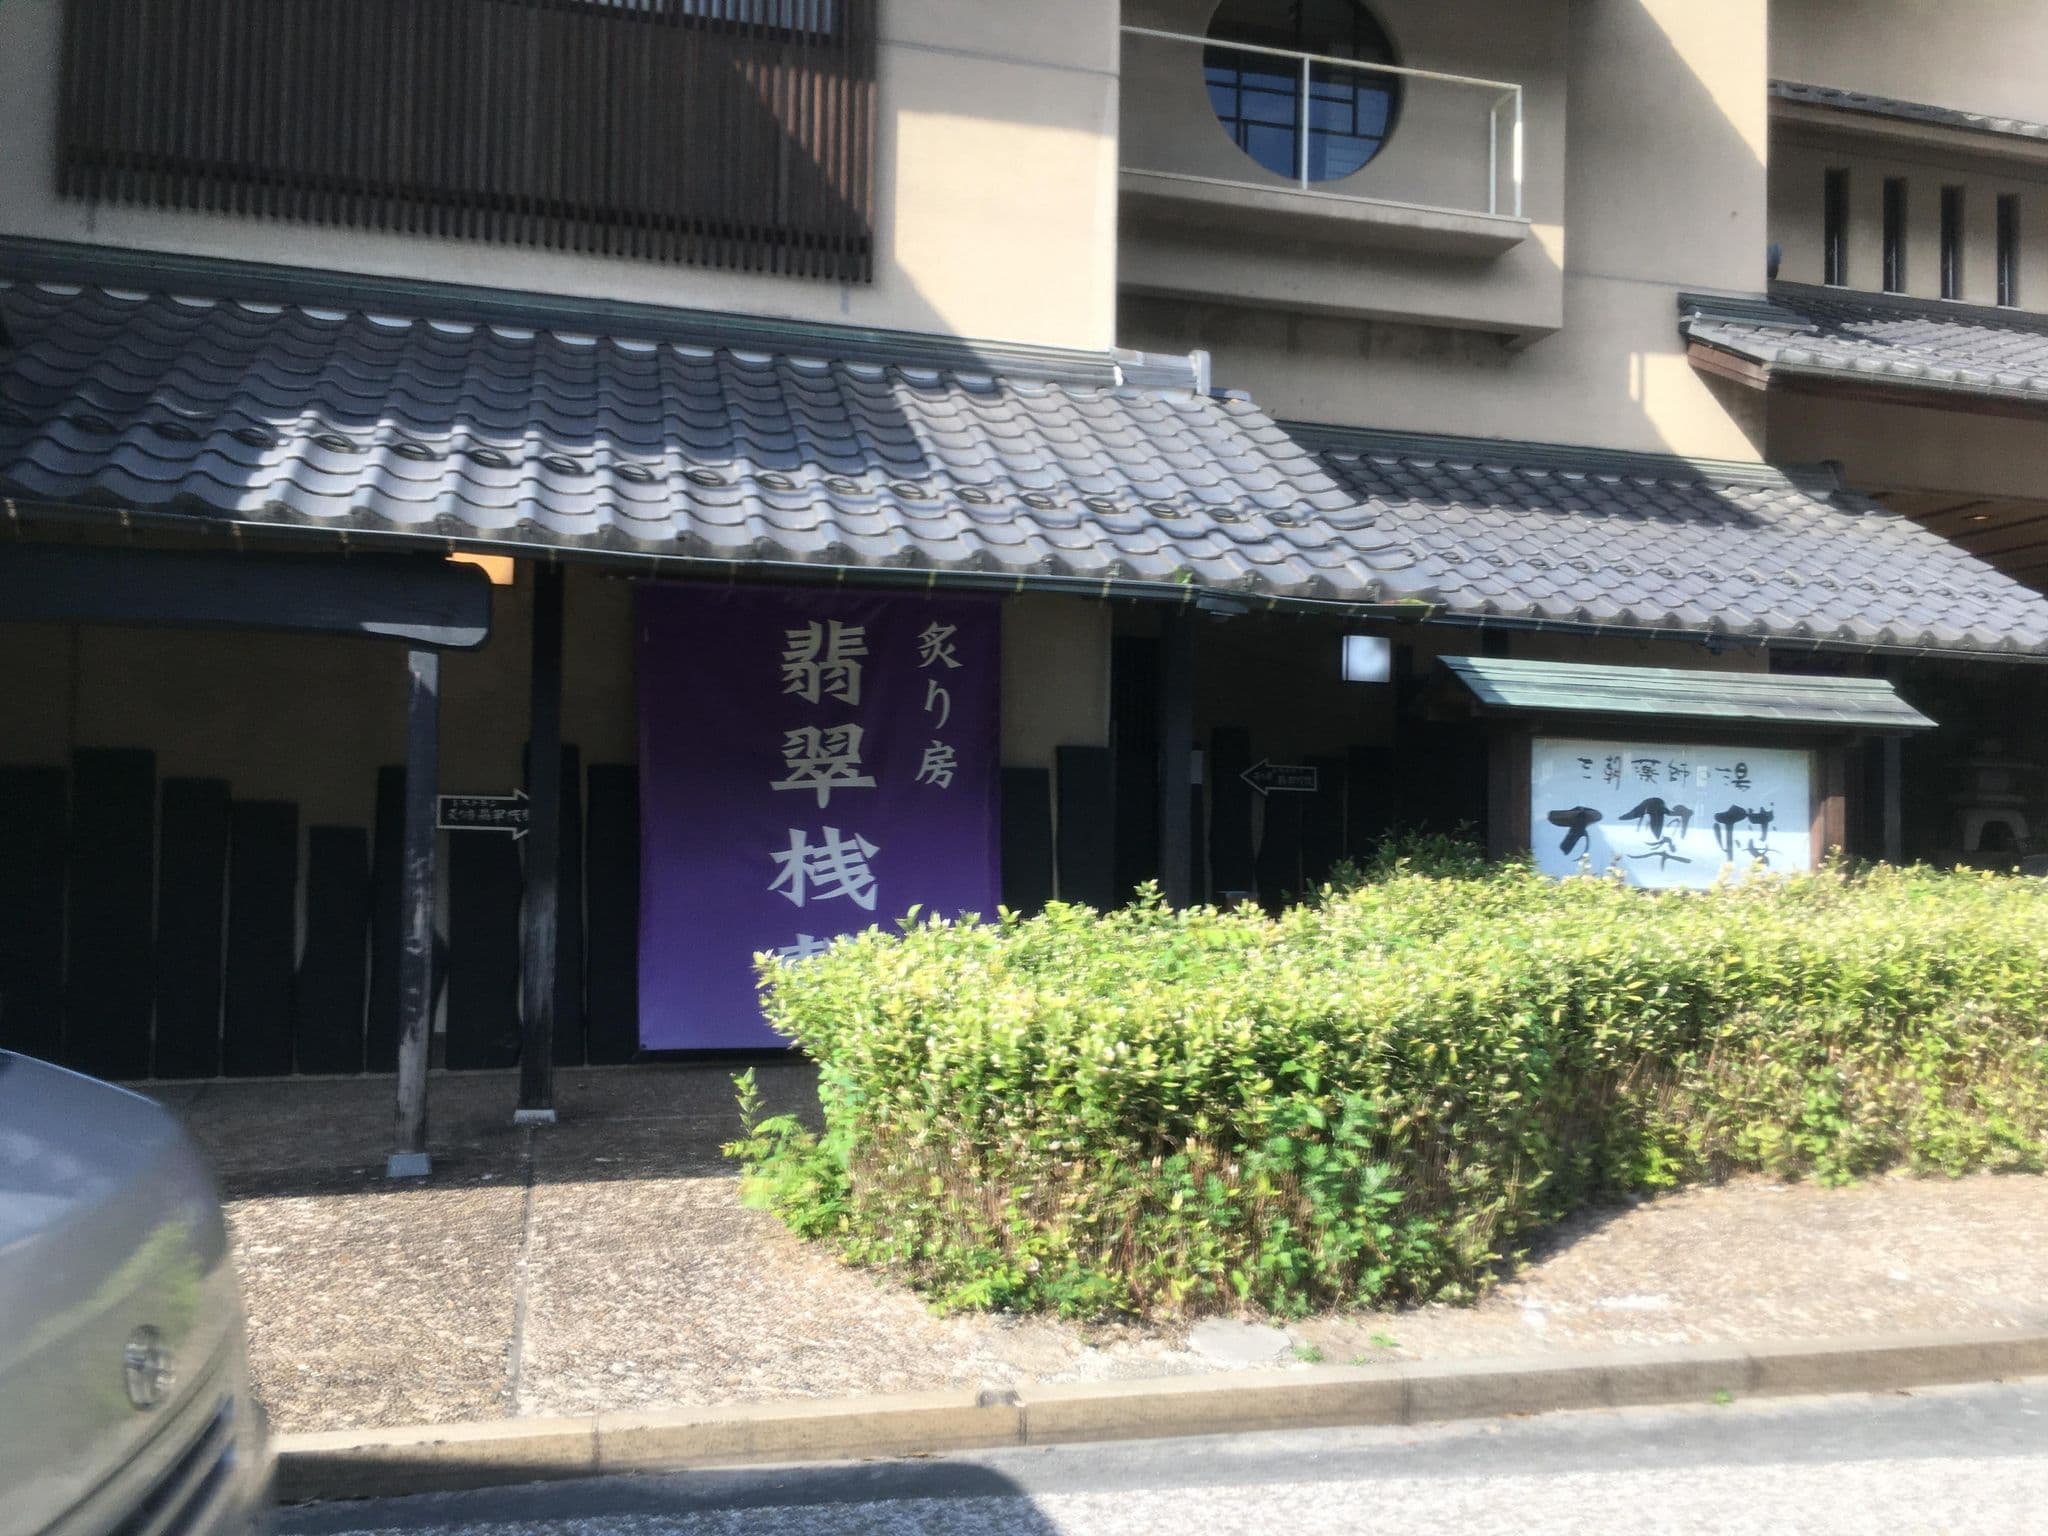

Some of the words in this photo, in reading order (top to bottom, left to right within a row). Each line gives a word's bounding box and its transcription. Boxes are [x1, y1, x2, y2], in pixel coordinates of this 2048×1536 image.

[767, 619, 881, 966] 翡翠桟
[915, 620, 964, 790] 炙り房
